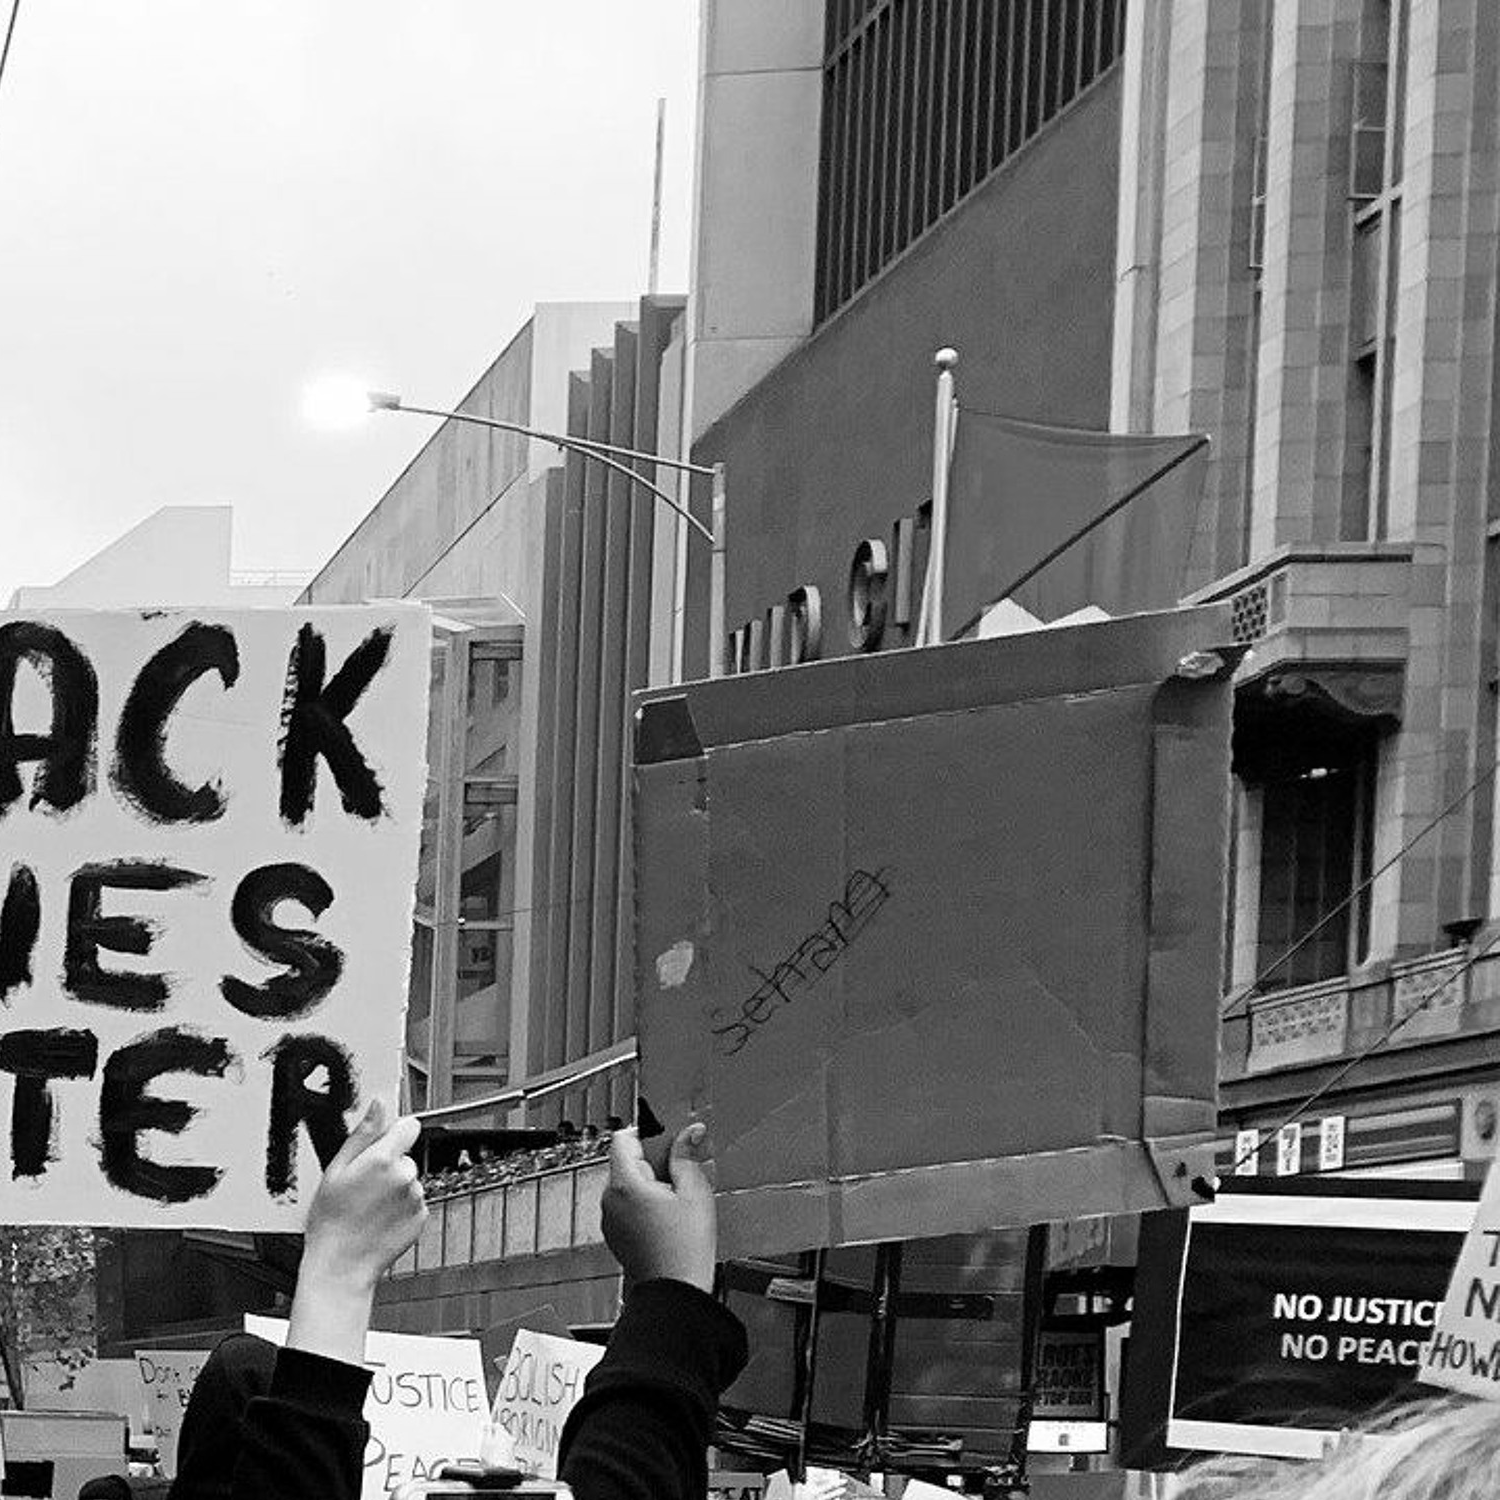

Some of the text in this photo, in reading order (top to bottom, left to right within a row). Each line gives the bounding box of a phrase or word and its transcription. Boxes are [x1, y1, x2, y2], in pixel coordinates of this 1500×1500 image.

[1273, 1292, 1323, 1321] NO
[1280, 1332, 1428, 1366] NO PEAC
[363, 1361, 480, 1413] USTICE
[363, 1435, 480, 1492] PEAC
